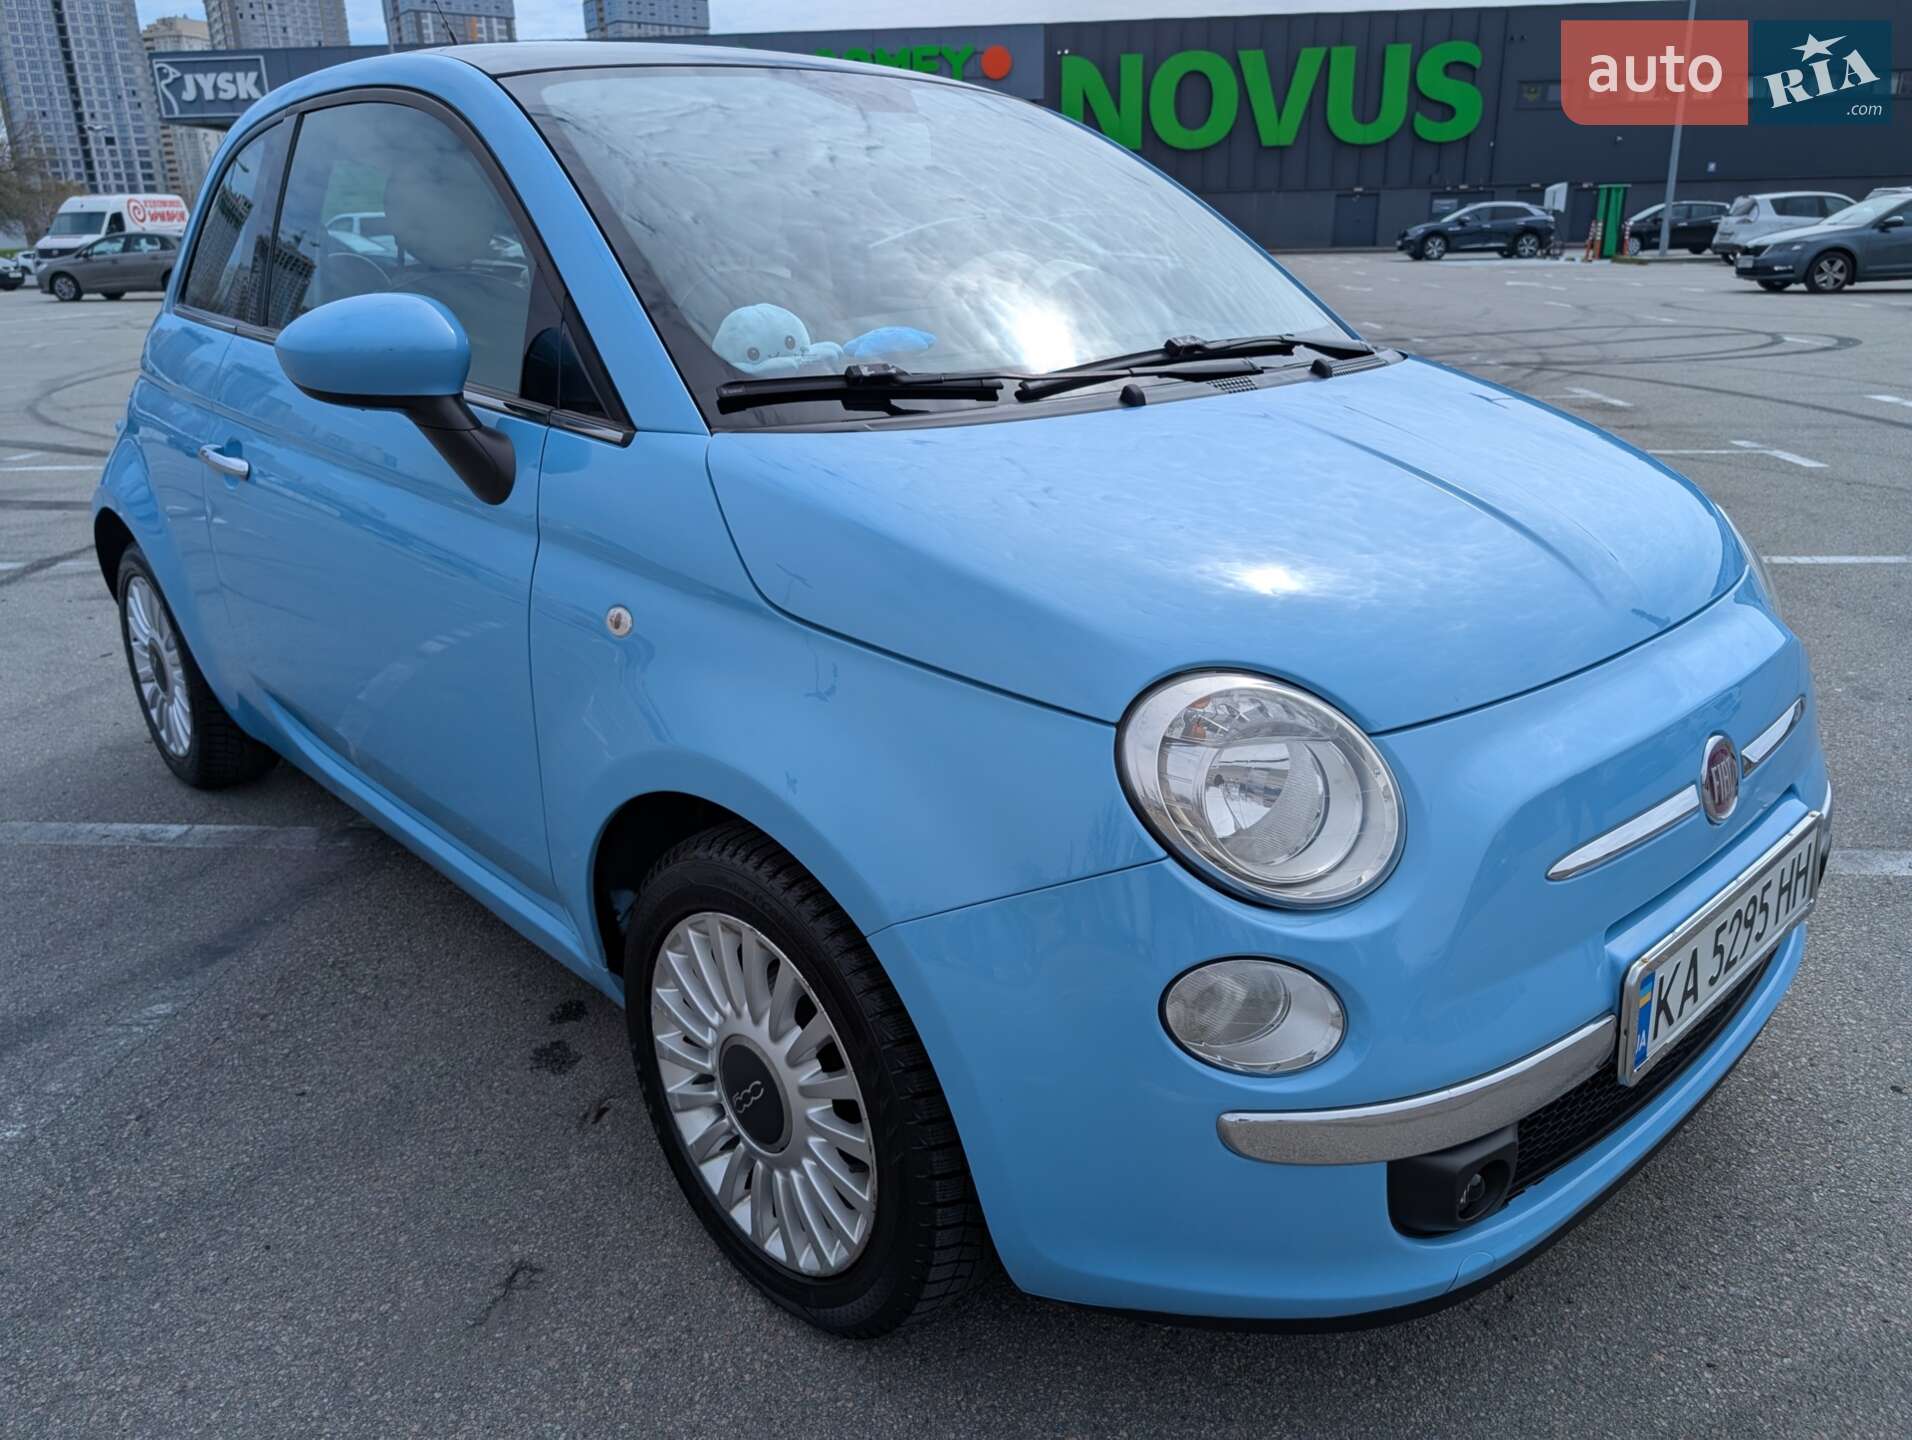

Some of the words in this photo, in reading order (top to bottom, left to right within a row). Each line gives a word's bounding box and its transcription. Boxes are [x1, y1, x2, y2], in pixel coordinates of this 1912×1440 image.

[181, 72, 262, 101] JYSK
[1061, 40, 1483, 151] NOVUS
[1710, 756, 1736, 804] FIAT
[1653, 946, 1698, 1040] KA
[1708, 879, 1773, 987] 5295
[1775, 843, 1812, 925] HH
